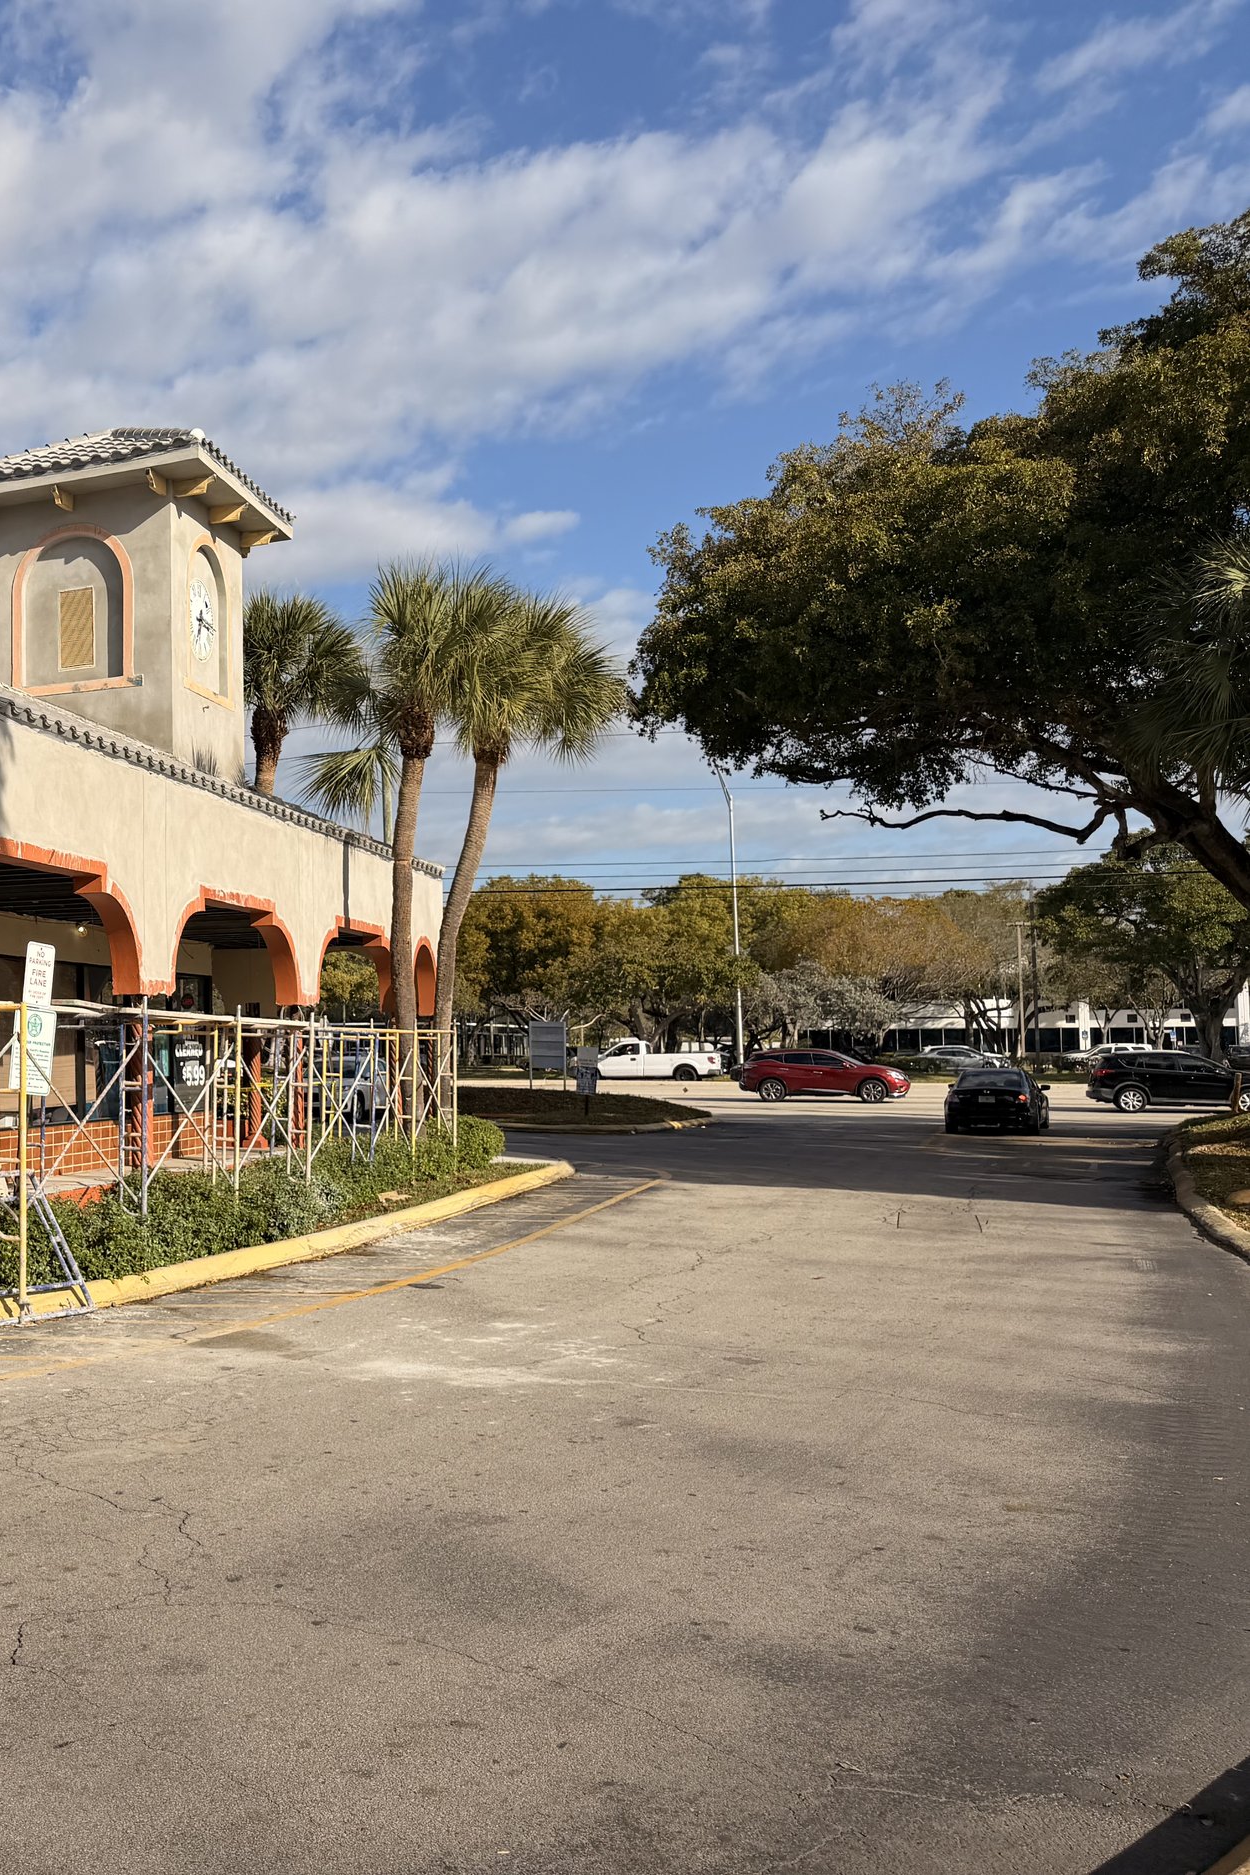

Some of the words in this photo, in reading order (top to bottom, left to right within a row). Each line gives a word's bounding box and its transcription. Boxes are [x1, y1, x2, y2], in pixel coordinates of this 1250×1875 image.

[29, 957, 52, 967] PARKING
[31, 969, 47, 978] FIRE
[30, 978, 47, 987] LANE
[182, 1065, 205, 1086] $5.99
